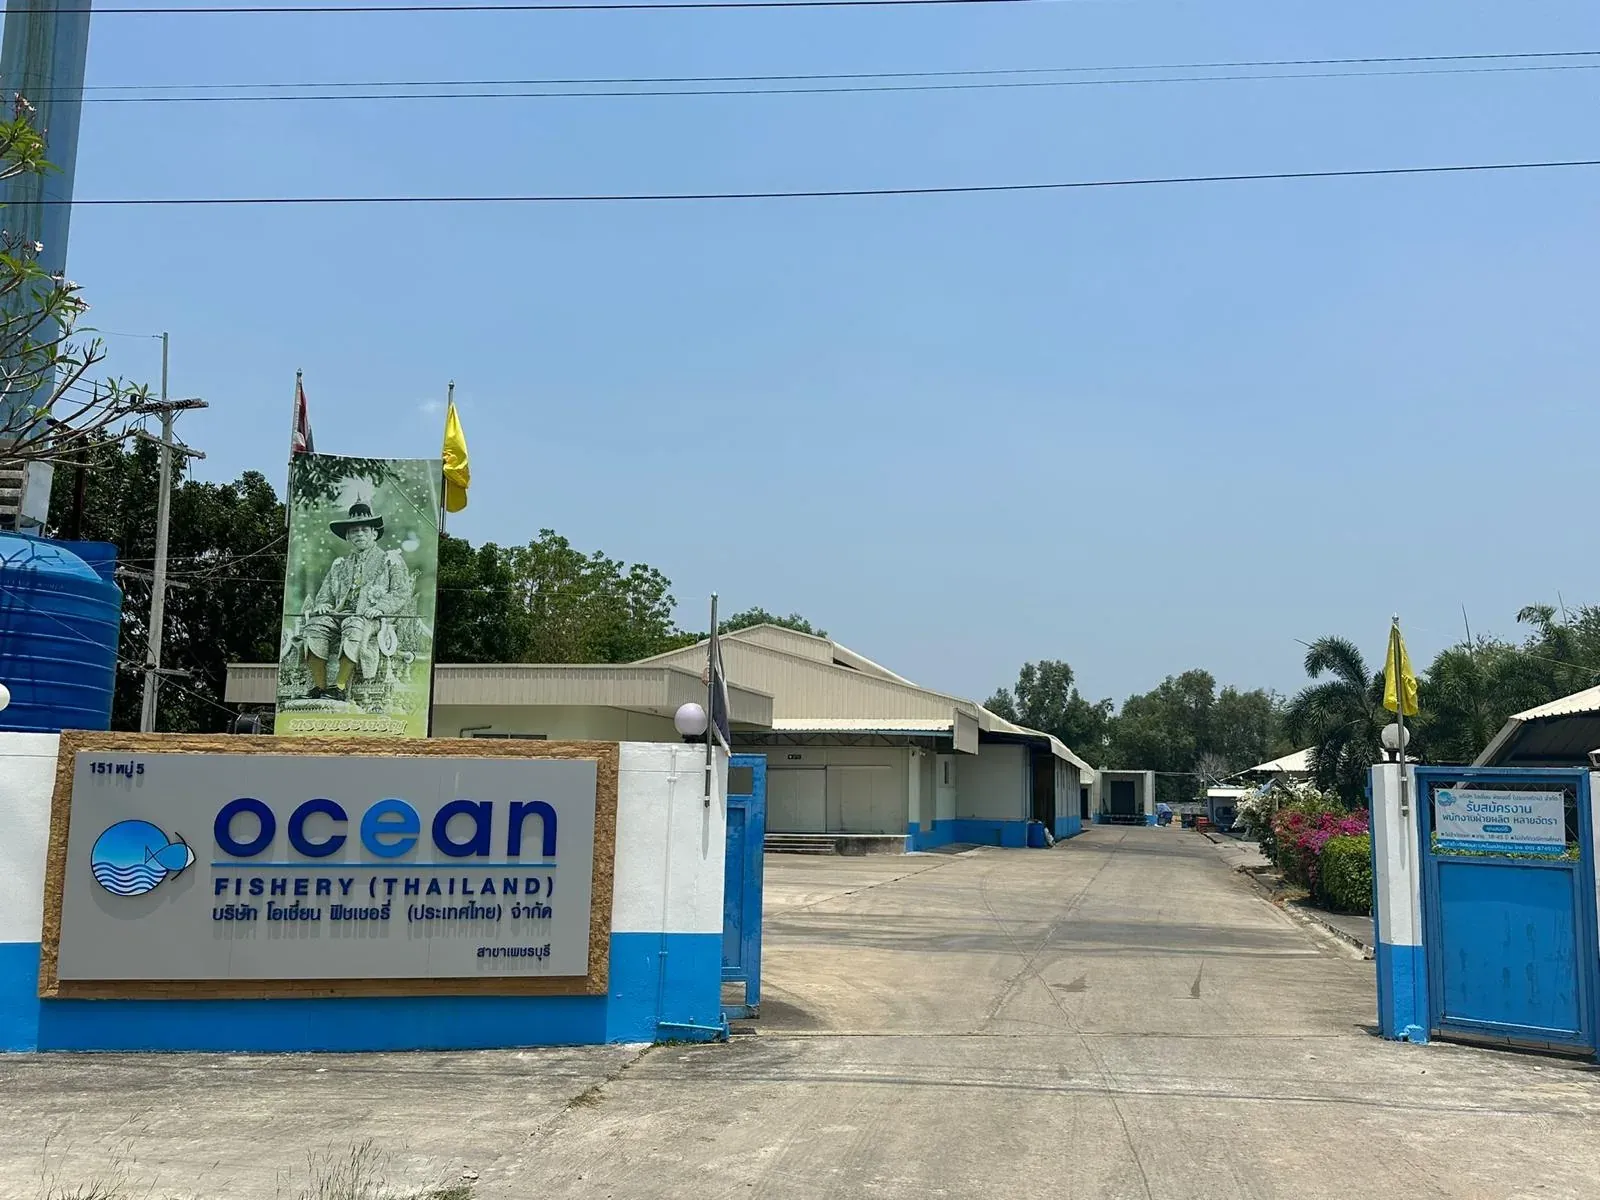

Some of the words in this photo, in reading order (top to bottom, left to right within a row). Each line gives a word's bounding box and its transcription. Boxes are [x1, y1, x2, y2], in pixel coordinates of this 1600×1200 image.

[289, 716, 408, 736] ทรงพระเจริญ
[89, 762, 113, 774] 151
[115, 760, 134, 778] หมู่
[136, 763, 145, 774] 5
[1466, 800, 1532, 814] รับสมัครงาน
[213, 797, 558, 858] ocean
[1442, 812, 1510, 824] พนักงานฝ่ายผลิต
[1514, 814, 1558, 825] หลายอัตรา
[214, 877, 355, 897] FISHERY
[369, 877, 555, 898] (THAILAND)
[212, 900, 258, 921] บริษัท
[266, 900, 321, 921] โอเชี่ยน
[330, 899, 392, 921] ฟิชเชอรี่
[407, 900, 502, 923] (ประเทศไทย)
[511, 900, 552, 920] จำกัด
[476, 943, 551, 961] สาขาเพชรบุรี
